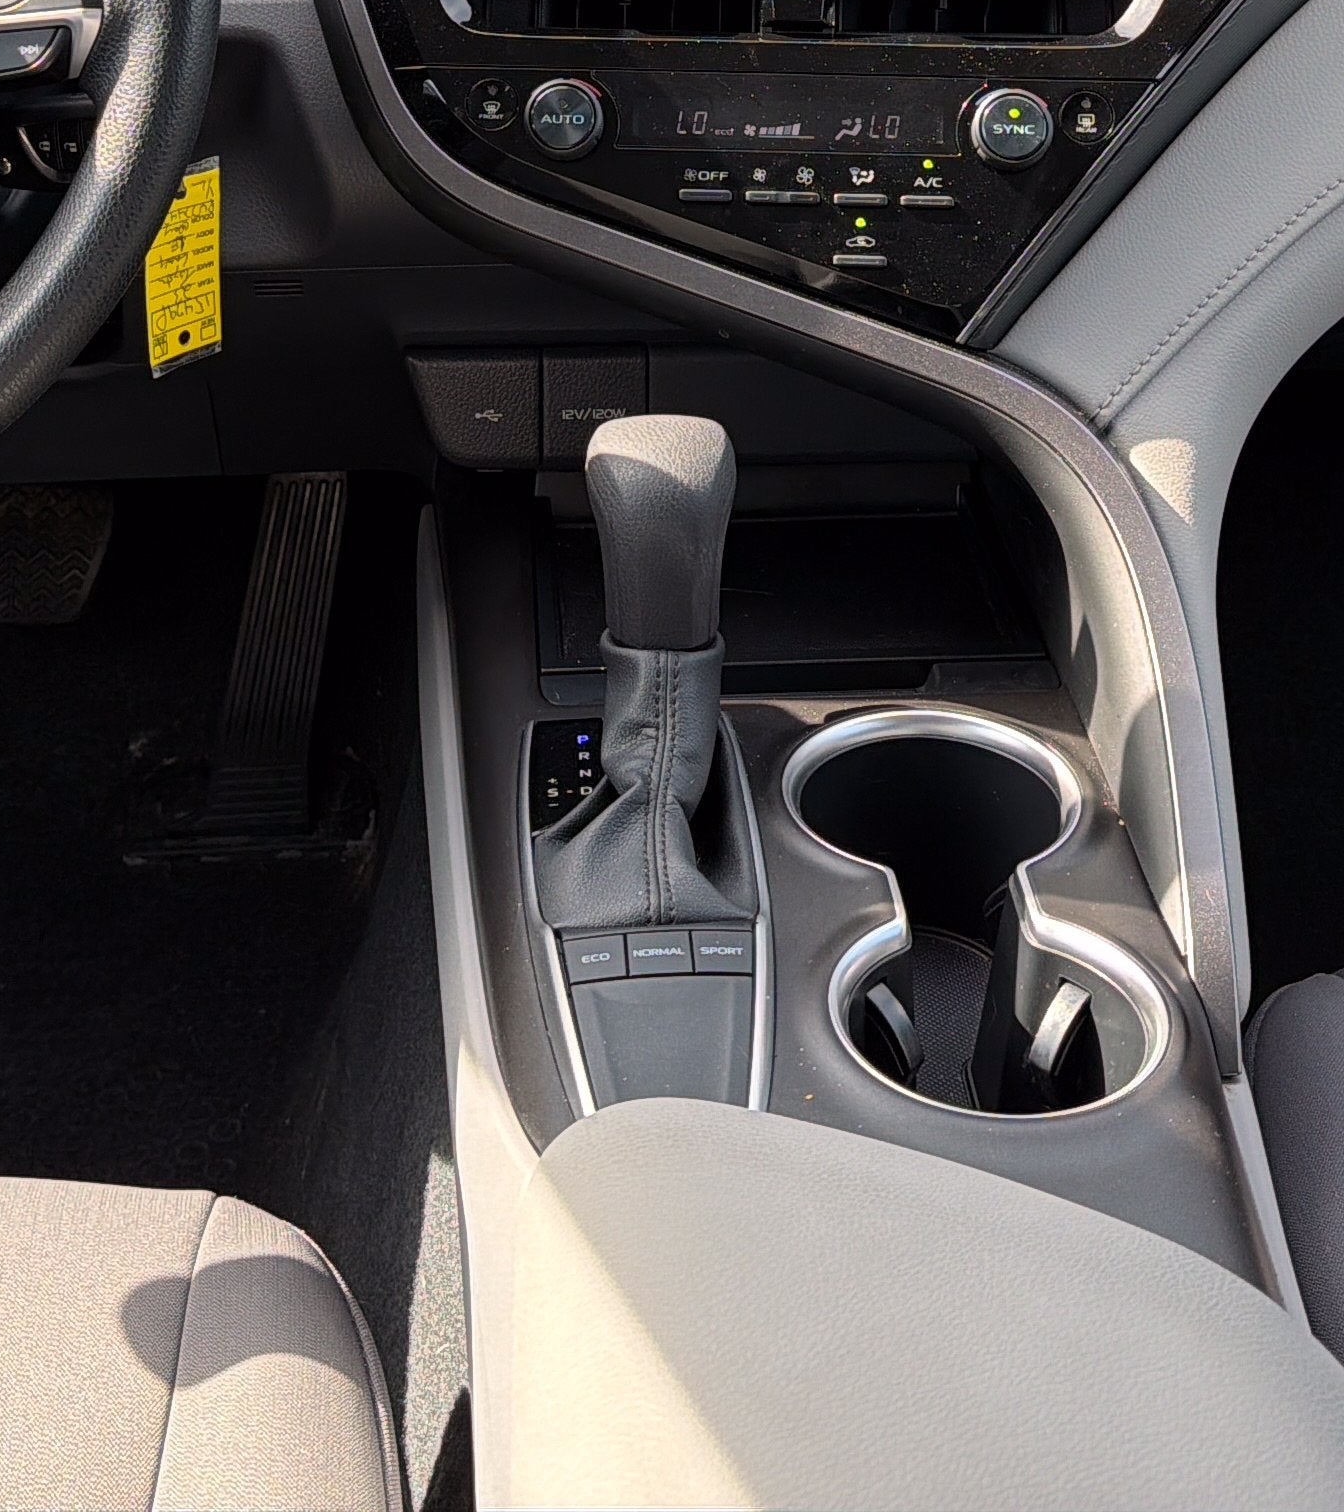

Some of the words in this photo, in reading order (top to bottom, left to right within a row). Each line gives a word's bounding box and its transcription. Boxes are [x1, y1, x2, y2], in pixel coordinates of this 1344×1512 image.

[541, 114, 585, 124] AUTO
[992, 123, 1035, 136] SYNC
[698, 170, 729, 181] OFF
[913, 176, 943, 188] A/C
[191, 212, 215, 224] COLOR
[196, 228, 215, 238] BODY
[191, 245, 215, 256] MODEL
[195, 261, 215, 272] MAKE
[197, 277, 215, 288] YEAR
[561, 407, 626, 420] 12V/120W
[576, 734, 590, 745] P
[578, 751, 591, 761] R
[579, 769, 592, 778] N
[546, 788, 559, 798] S
[580, 786, 593, 795] D
[632, 946, 686, 958] NORMAL
[699, 945, 744, 956] SPORT
[581, 952, 611, 964] ECO
